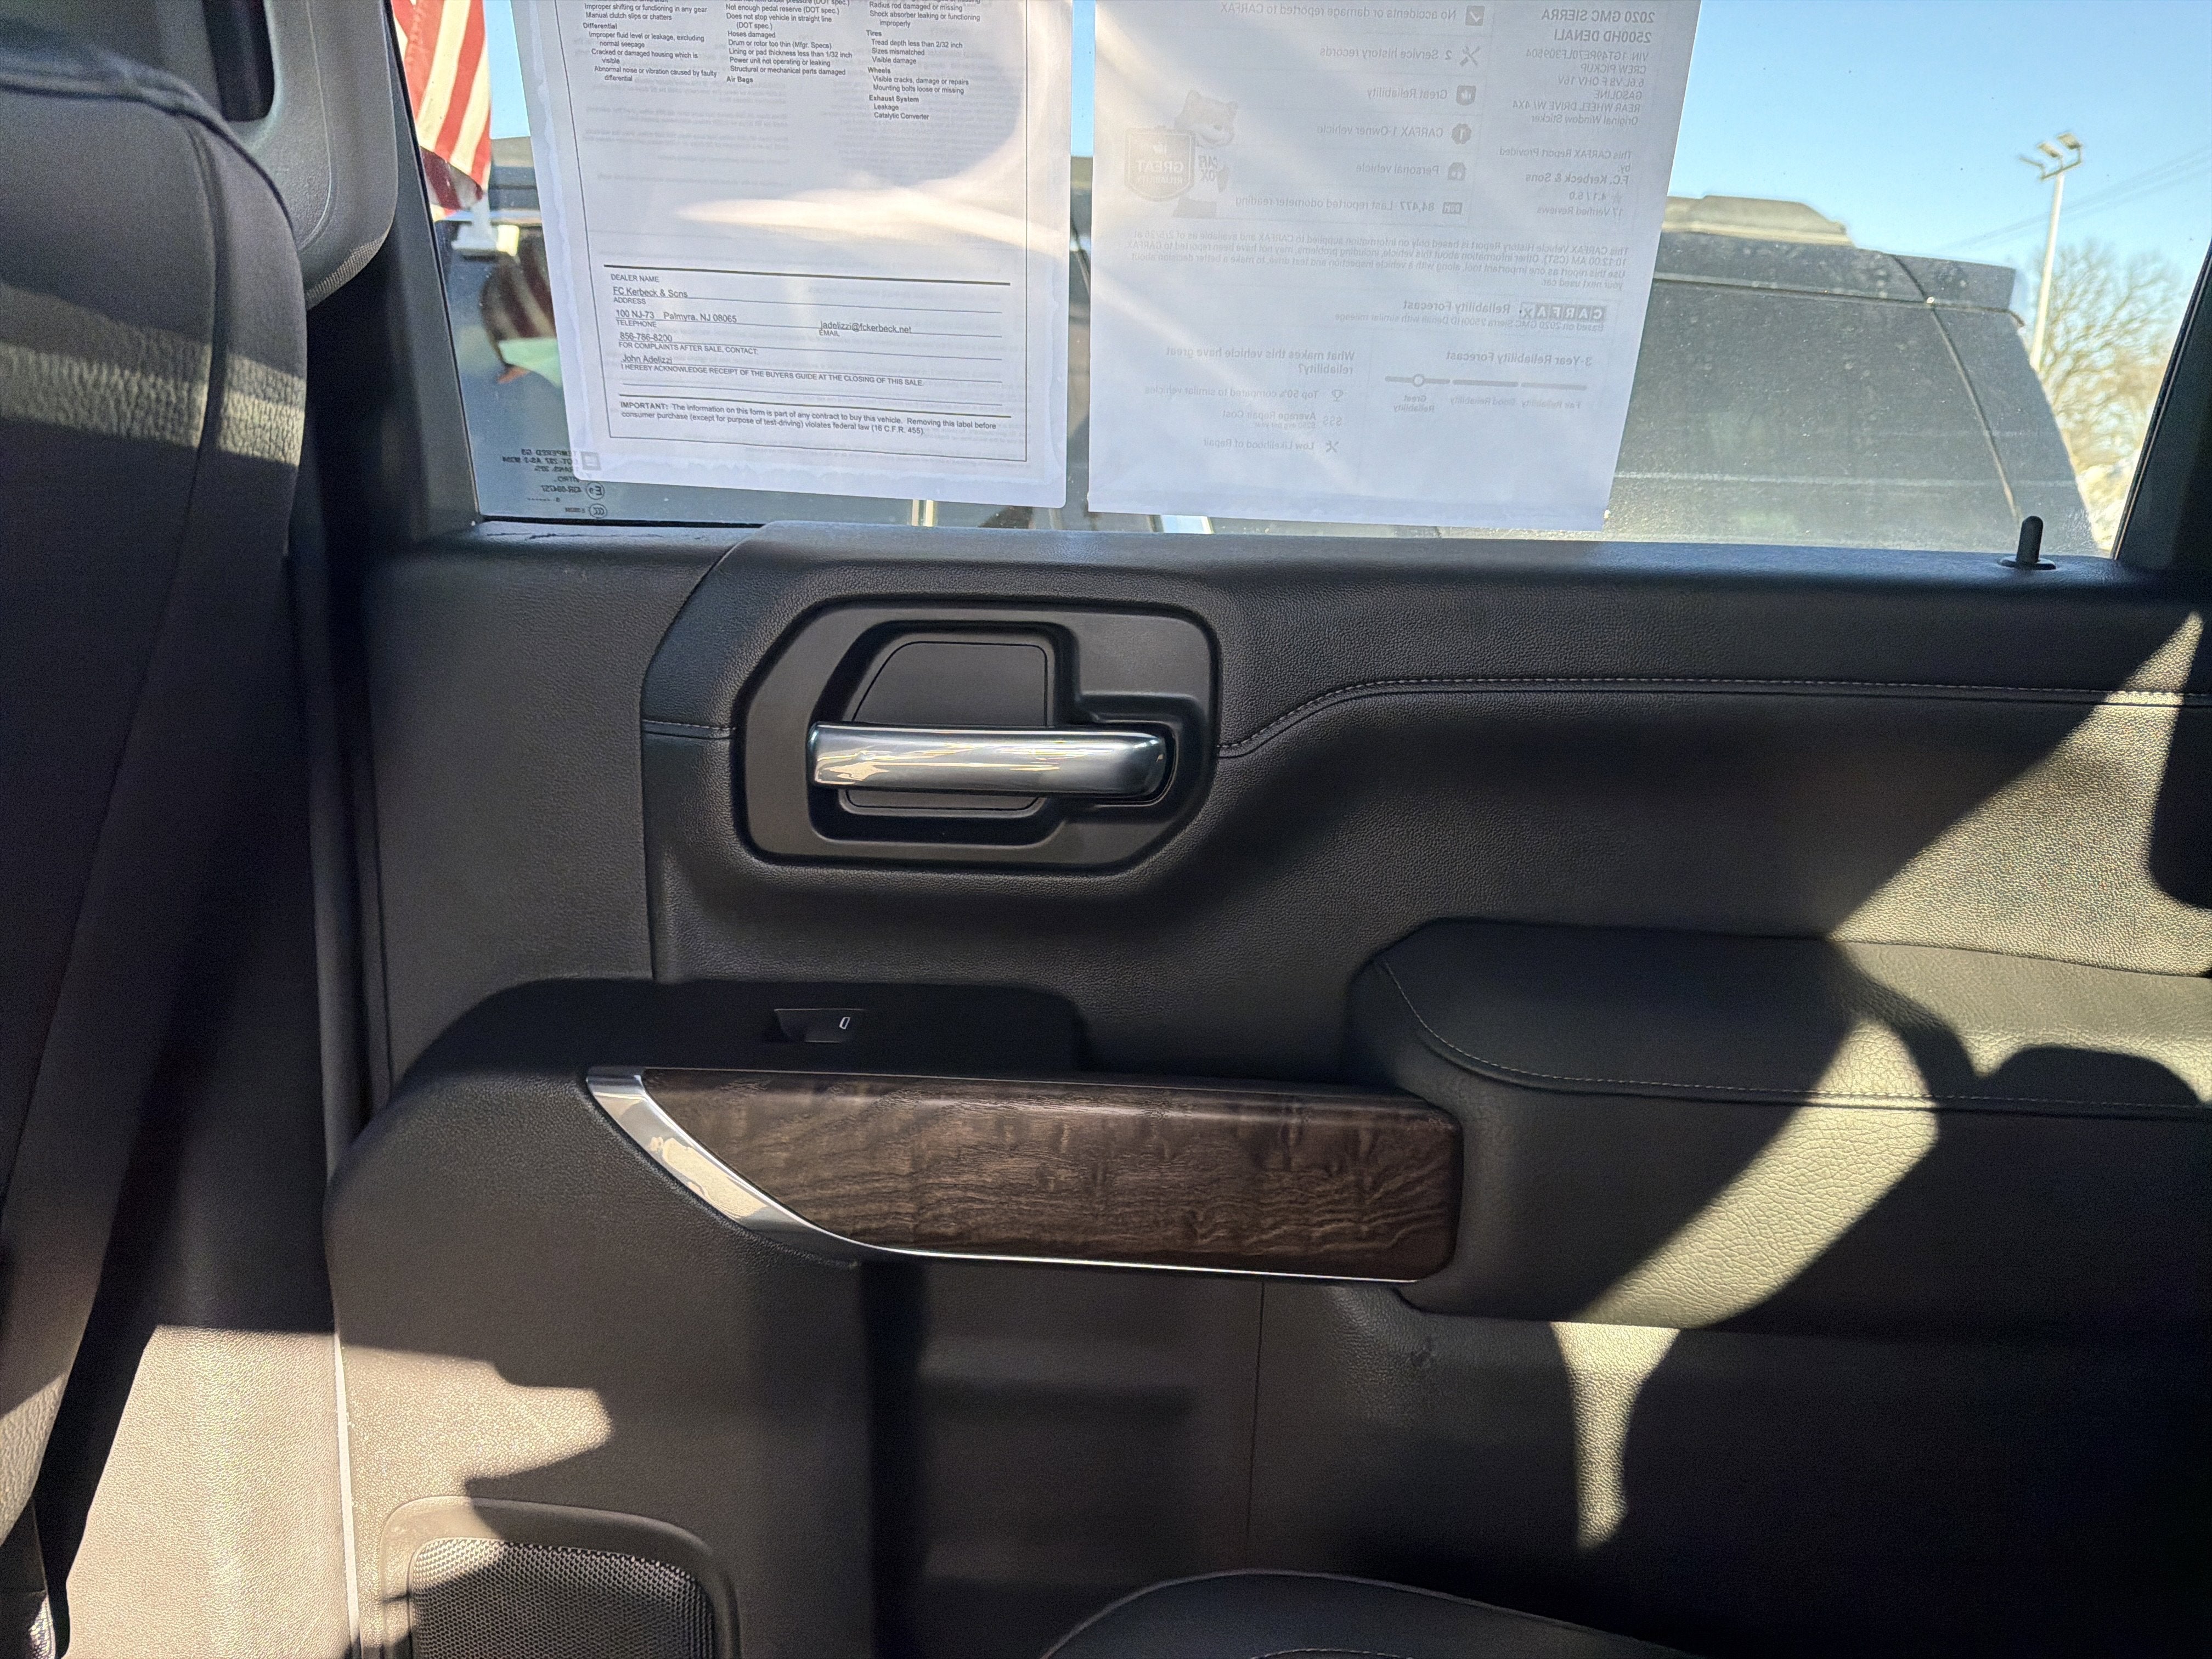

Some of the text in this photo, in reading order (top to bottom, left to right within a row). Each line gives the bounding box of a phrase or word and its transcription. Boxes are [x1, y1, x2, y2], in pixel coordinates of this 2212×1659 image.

[817, 68, 845, 76] damaged
[613, 287, 624, 296] FC
[625, 287, 657, 296] Kerbeck
[616, 309, 630, 318] 100
[631, 310, 654, 319] NJ-73
[699, 313, 711, 322] NJ
[712, 314, 737, 323] 08065
[633, 342, 679, 351] COMPLAINTS
[642, 355, 672, 364] Adelizzi
[624, 364, 652, 372] HEREBY
[652, 365, 708, 375] ACKNOWLEDGE
[765, 371, 794, 380] BUYERS
[843, 376, 875, 384] CLOSING
[620, 402, 668, 411] IMPORTANT:
[686, 405, 725, 414] information
[773, 410, 788, 419] part
[849, 415, 862, 423] buy
[906, 417, 941, 427] Removing
[656, 413, 688, 422] purchase
[689, 415, 715, 424] (except
[726, 418, 754, 426] purpose
[763, 419, 804, 429] test-driving)
[871, 425, 882, 434] (16
